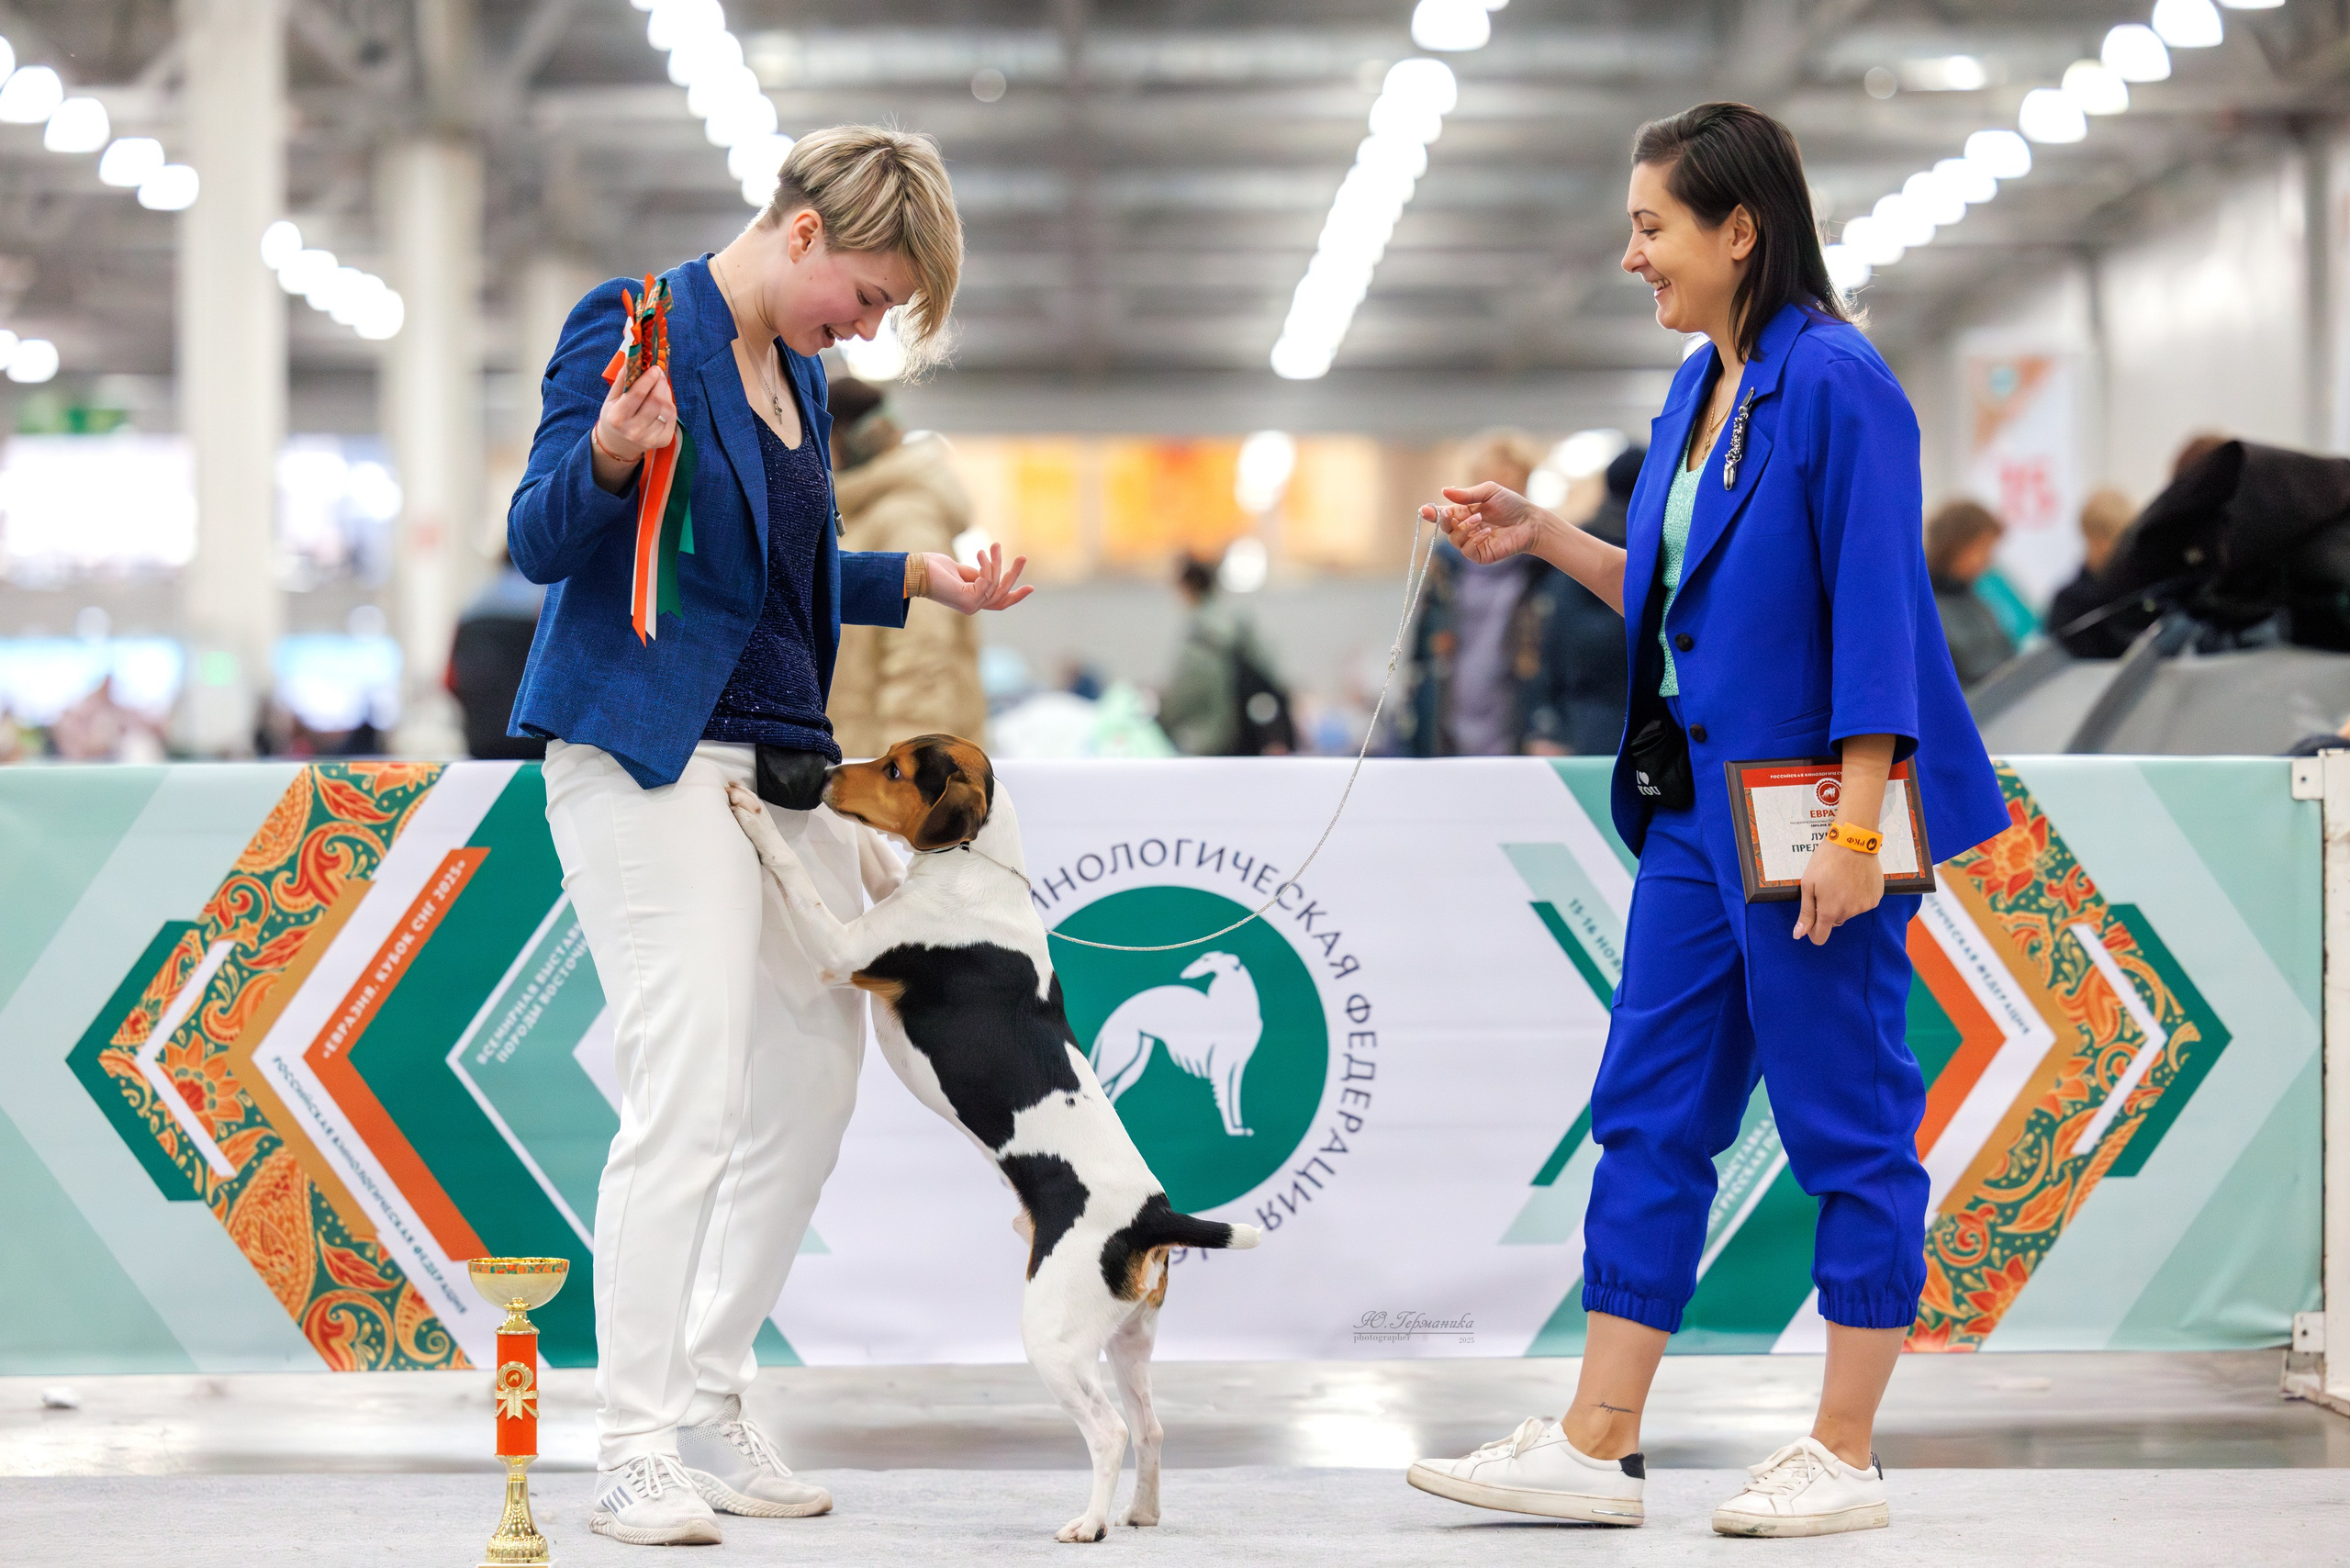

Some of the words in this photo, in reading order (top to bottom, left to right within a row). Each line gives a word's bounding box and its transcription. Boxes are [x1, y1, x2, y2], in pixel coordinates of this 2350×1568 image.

[1638, 785, 1662, 796] YOU
[1810, 809, 1838, 818] ЕВРА
[1846, 836, 1865, 846] РКФ
[375, 932, 415, 982] КУБОК
[410, 899, 436, 931] СНГ
[476, 982, 540, 1066] ВСЕМИРНАЯ
[496, 1002, 543, 1064] ПОРОДЫ
[538, 936, 589, 1006] ВОСТОЧН
[1031, 838, 1360, 980] ИНОЛОГИЧЕСКАЯ
[1255, 992, 1378, 1232] ФЕДЕРАЦИЯ
[1976, 964, 2031, 1035] ФЕДЕРАЦИЯ
[273, 1056, 334, 1137] РОССИЙСКАЯ
[331, 1135, 416, 1246] КИНОЛОГИЧЕСКАЯ
[413, 1244, 468, 1315] ФЕДЕРАЦИЯ
